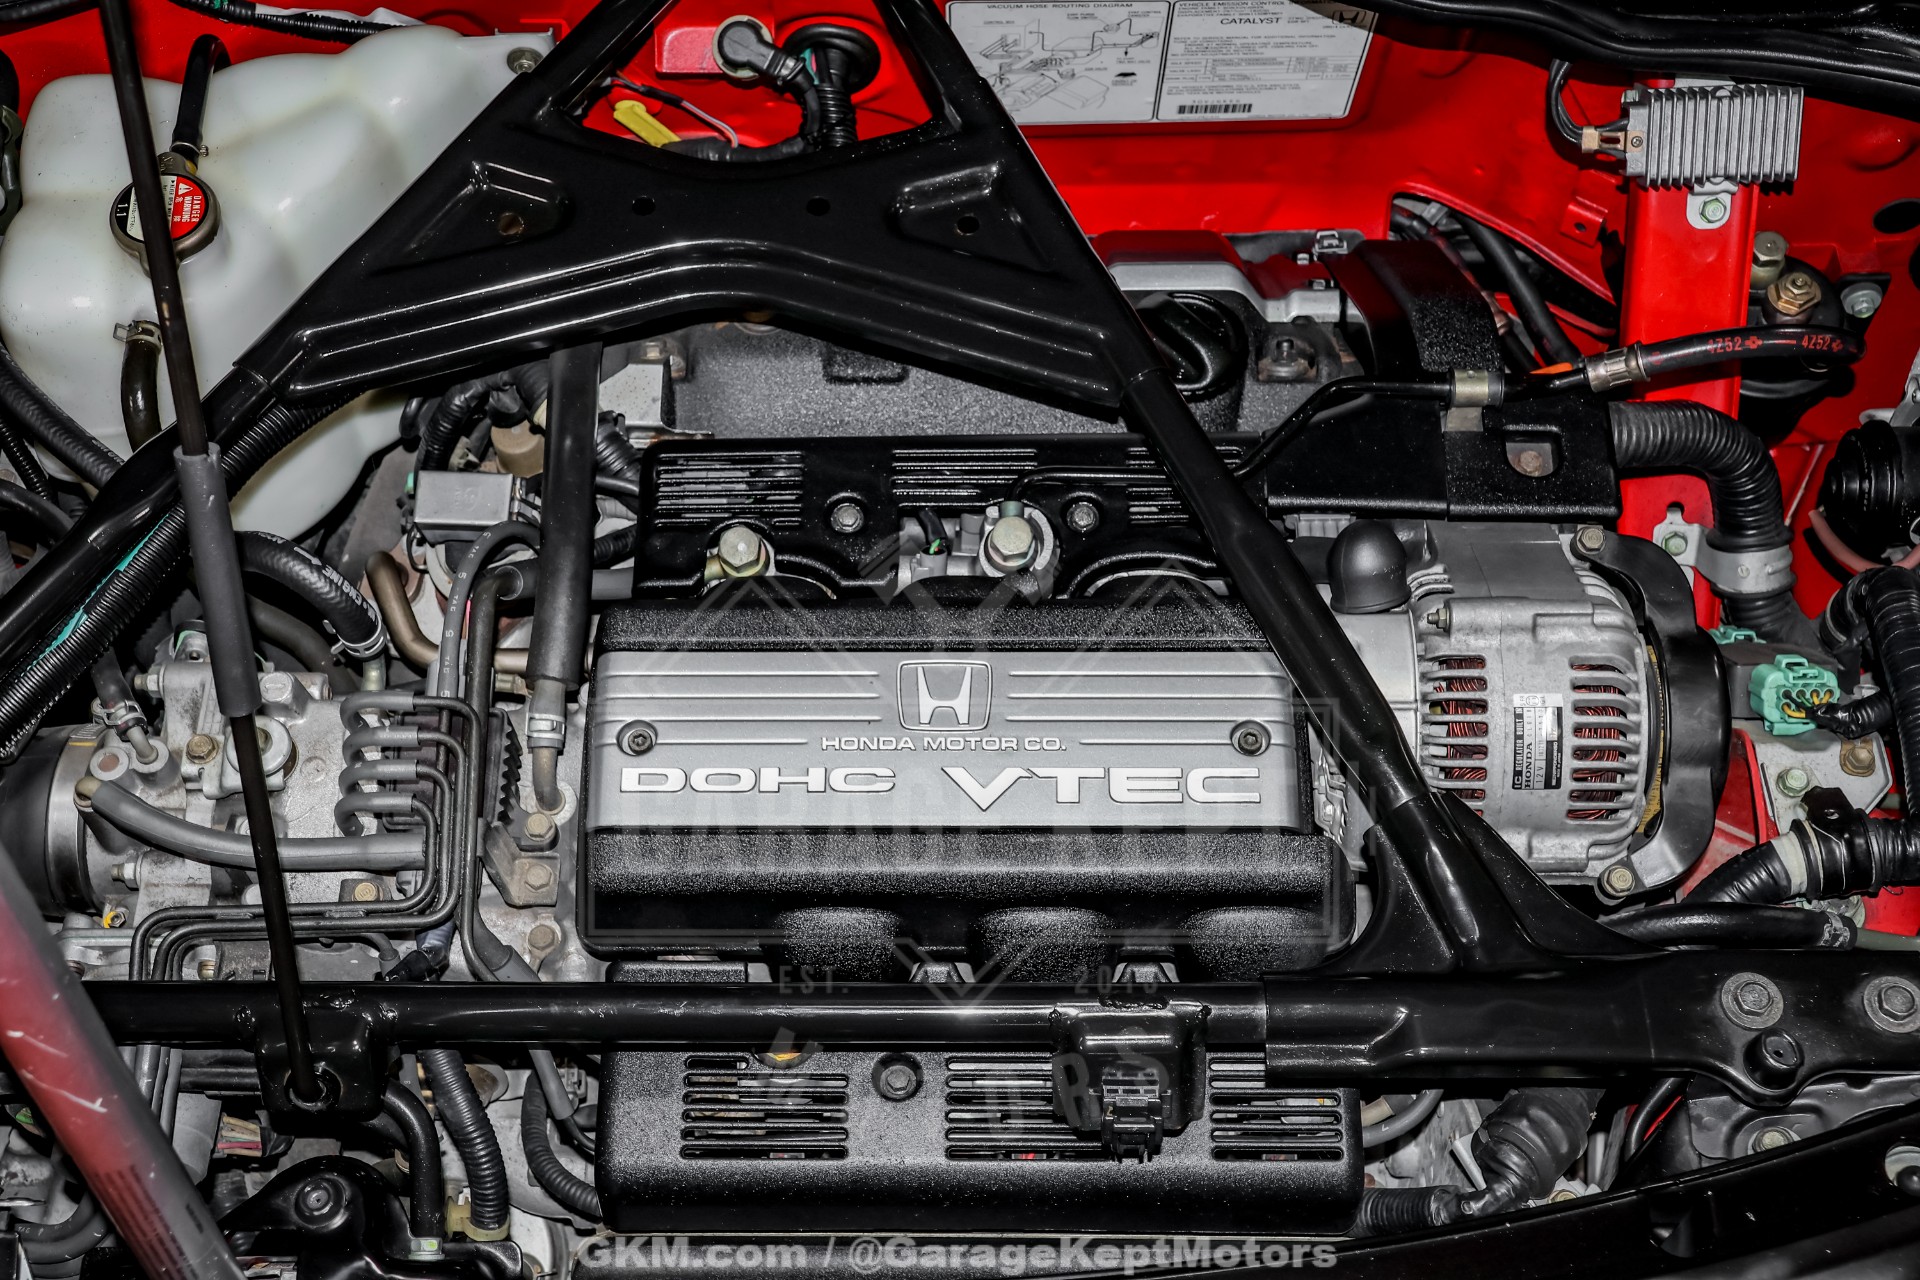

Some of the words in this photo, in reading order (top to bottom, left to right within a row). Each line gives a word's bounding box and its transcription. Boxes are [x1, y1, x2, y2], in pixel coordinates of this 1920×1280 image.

[1220, 17, 1282, 25] CATALYST
[116, 203, 129, 217] 1.1
[181, 195, 193, 223] WARNING
[191, 195, 202, 222] DANGER
[321, 564, 362, 606] ENGINE
[1516, 718, 1524, 735] BUILT
[821, 736, 916, 751] HONDA
[923, 736, 1019, 751] MOTOR
[1023, 736, 1067, 751] CO.
[1515, 739, 1524, 771] REGULATOR
[1524, 742, 1533, 789] HONDA
[619, 766, 897, 794] DOHC
[941, 766, 1262, 812] VTEC
[1514, 775, 1522, 788] IC
